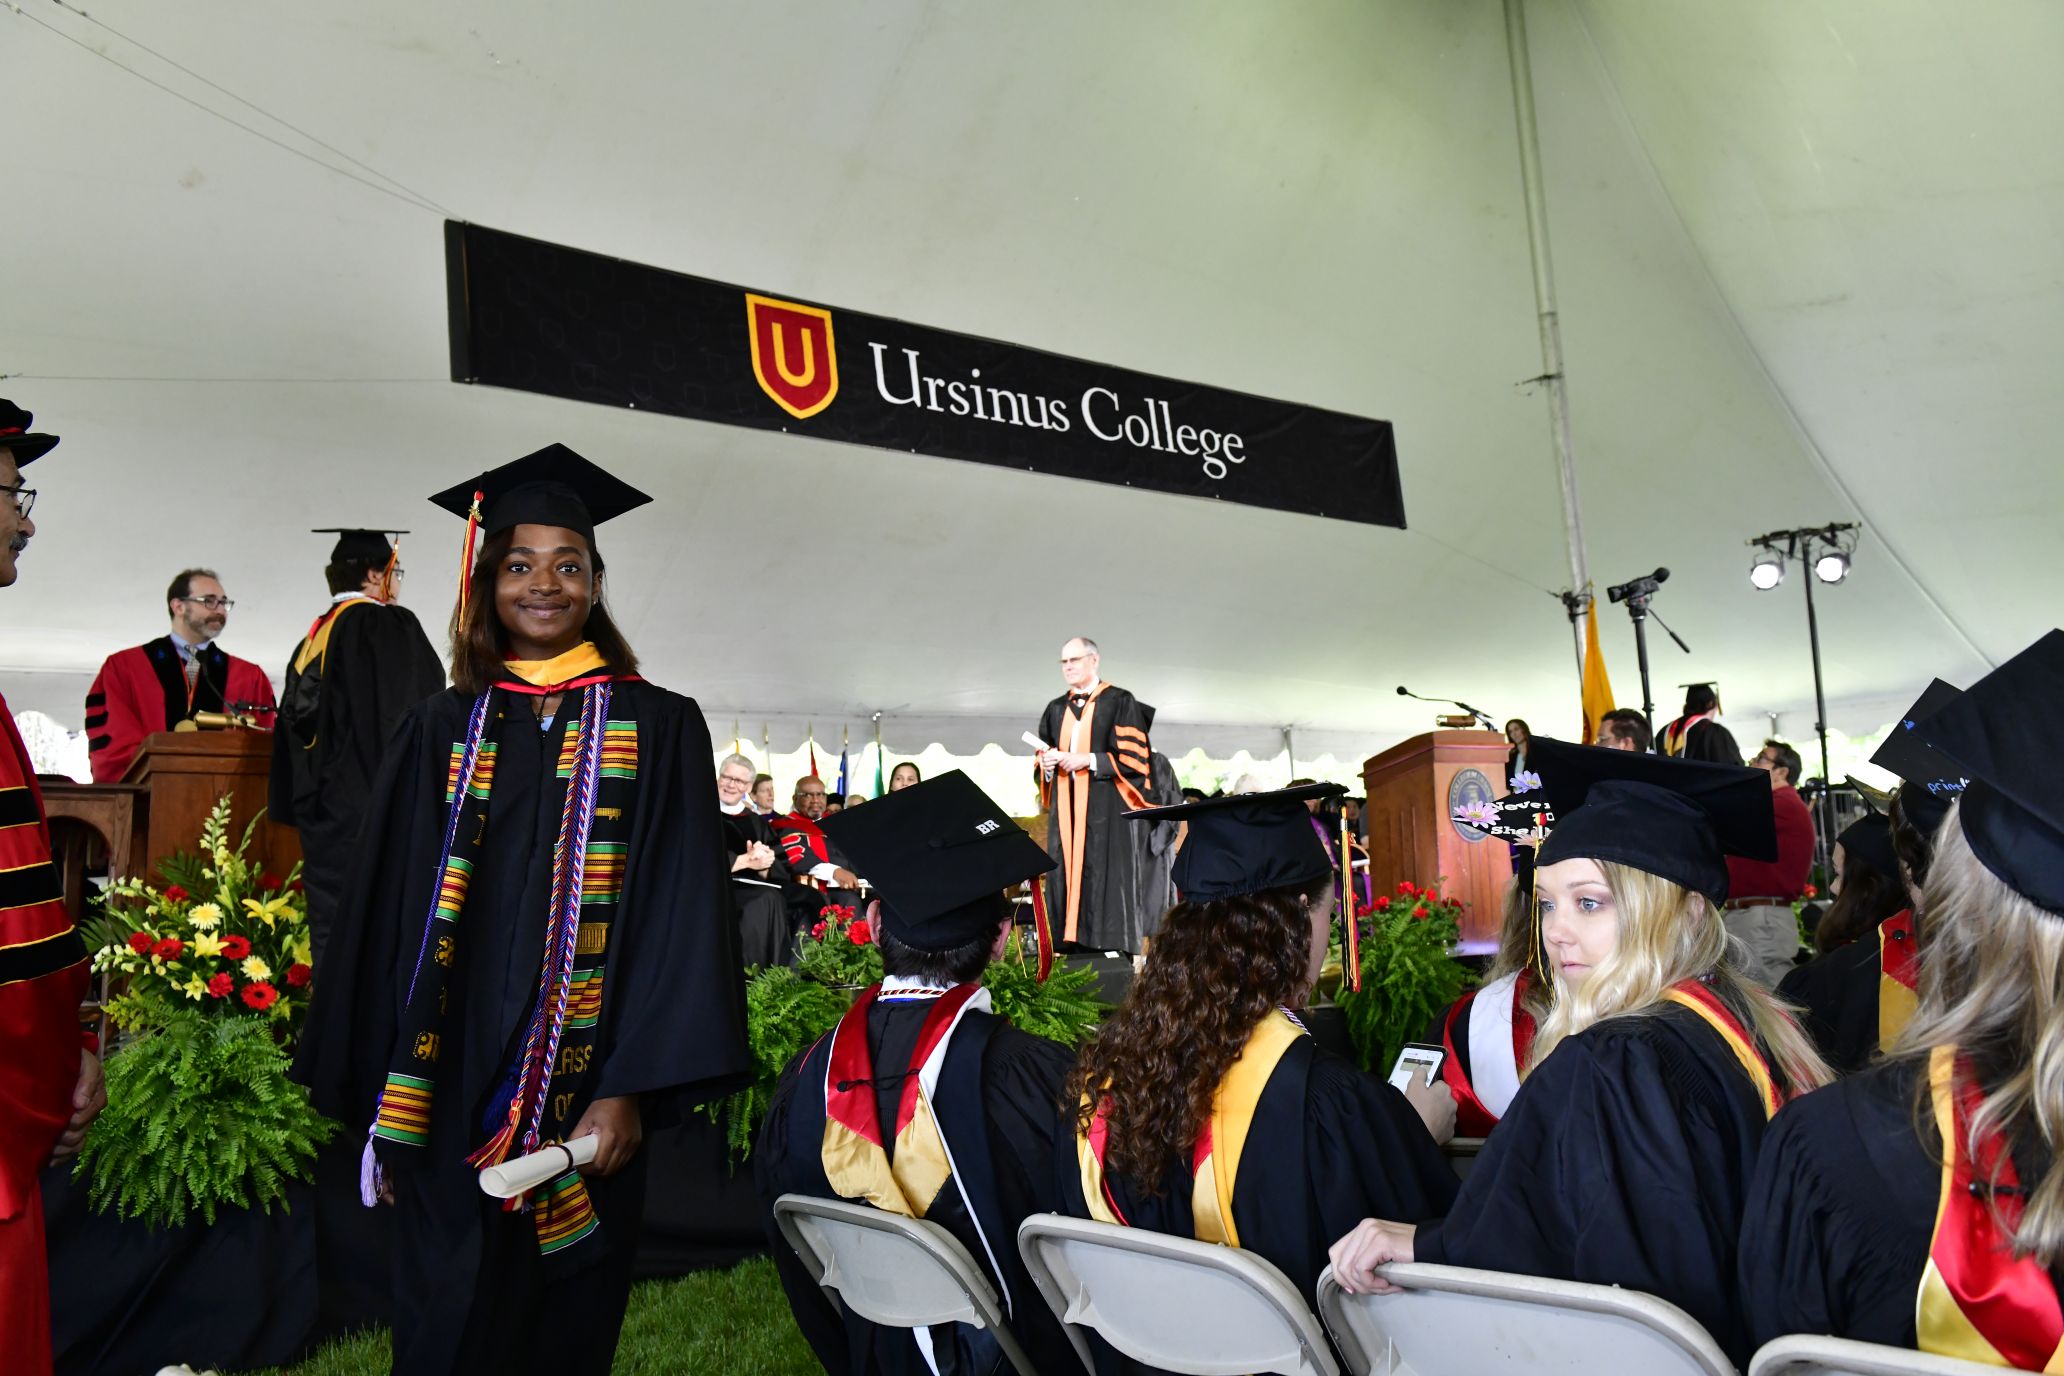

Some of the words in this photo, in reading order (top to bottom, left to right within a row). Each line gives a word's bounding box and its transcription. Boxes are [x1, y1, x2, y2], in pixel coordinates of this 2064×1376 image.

[771, 321, 816, 388] U
[867, 341, 1071, 433] Ursinus
[1081, 387, 1247, 481] College
[976, 819, 1000, 835] BR
